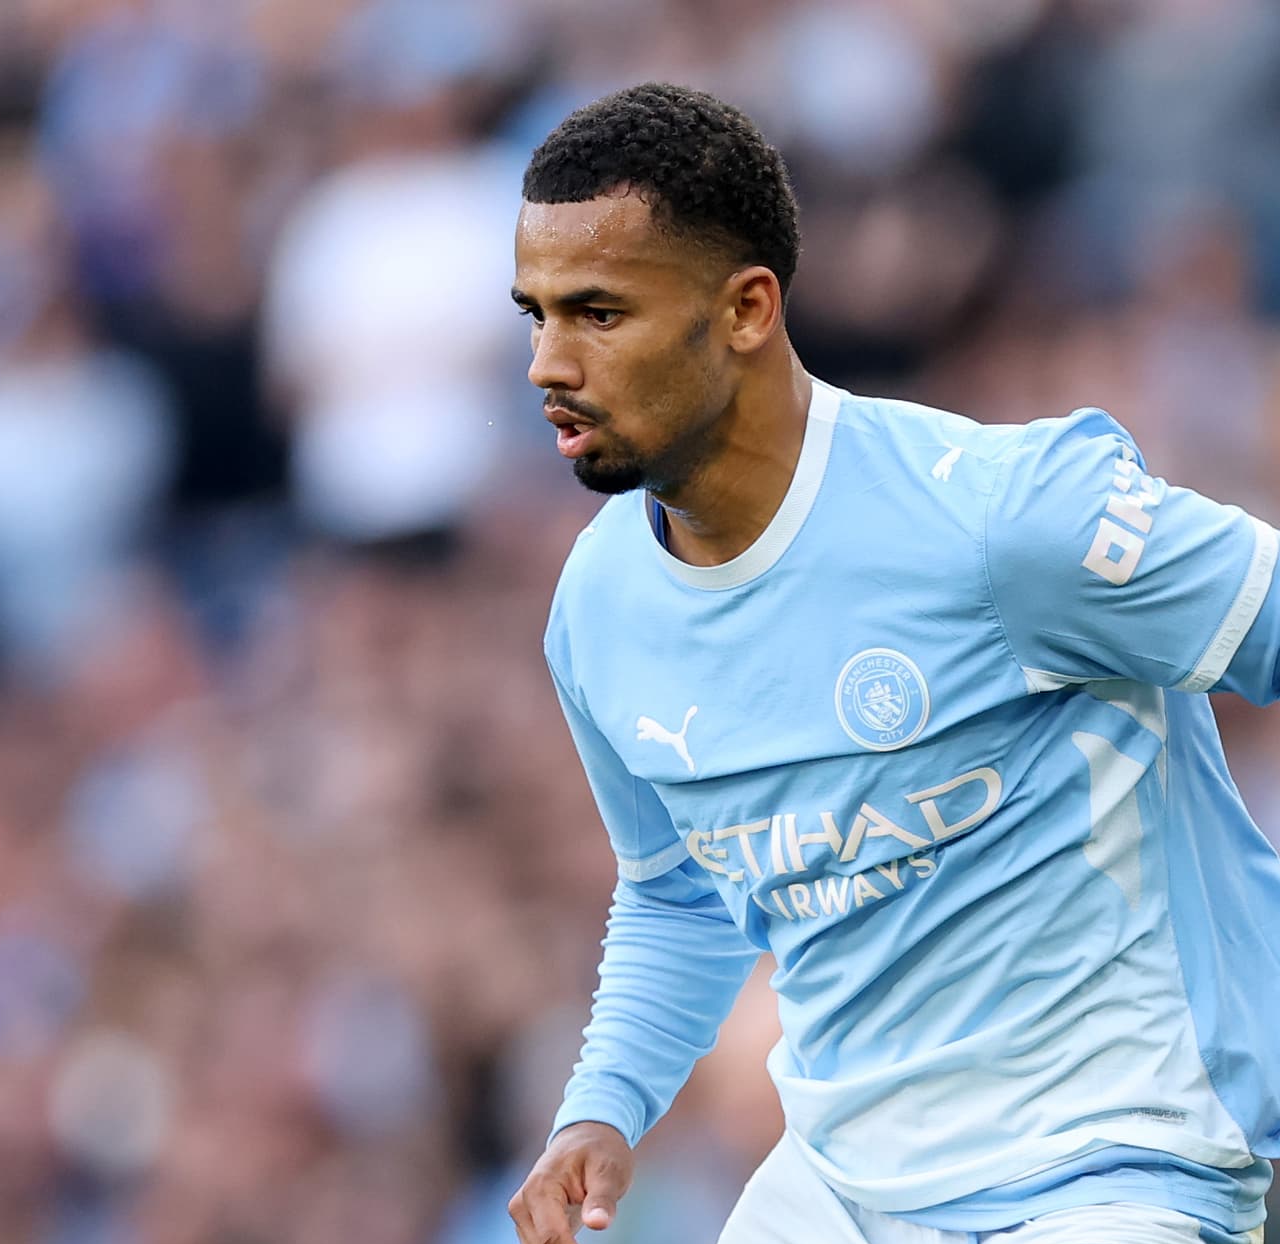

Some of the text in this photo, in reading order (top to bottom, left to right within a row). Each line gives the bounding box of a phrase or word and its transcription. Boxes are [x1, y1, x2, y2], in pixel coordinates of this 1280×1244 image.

[843, 658, 912, 696] MANCHESTER
[878, 729, 905, 742] CITY
[686, 767, 1002, 882] ETIHAD
